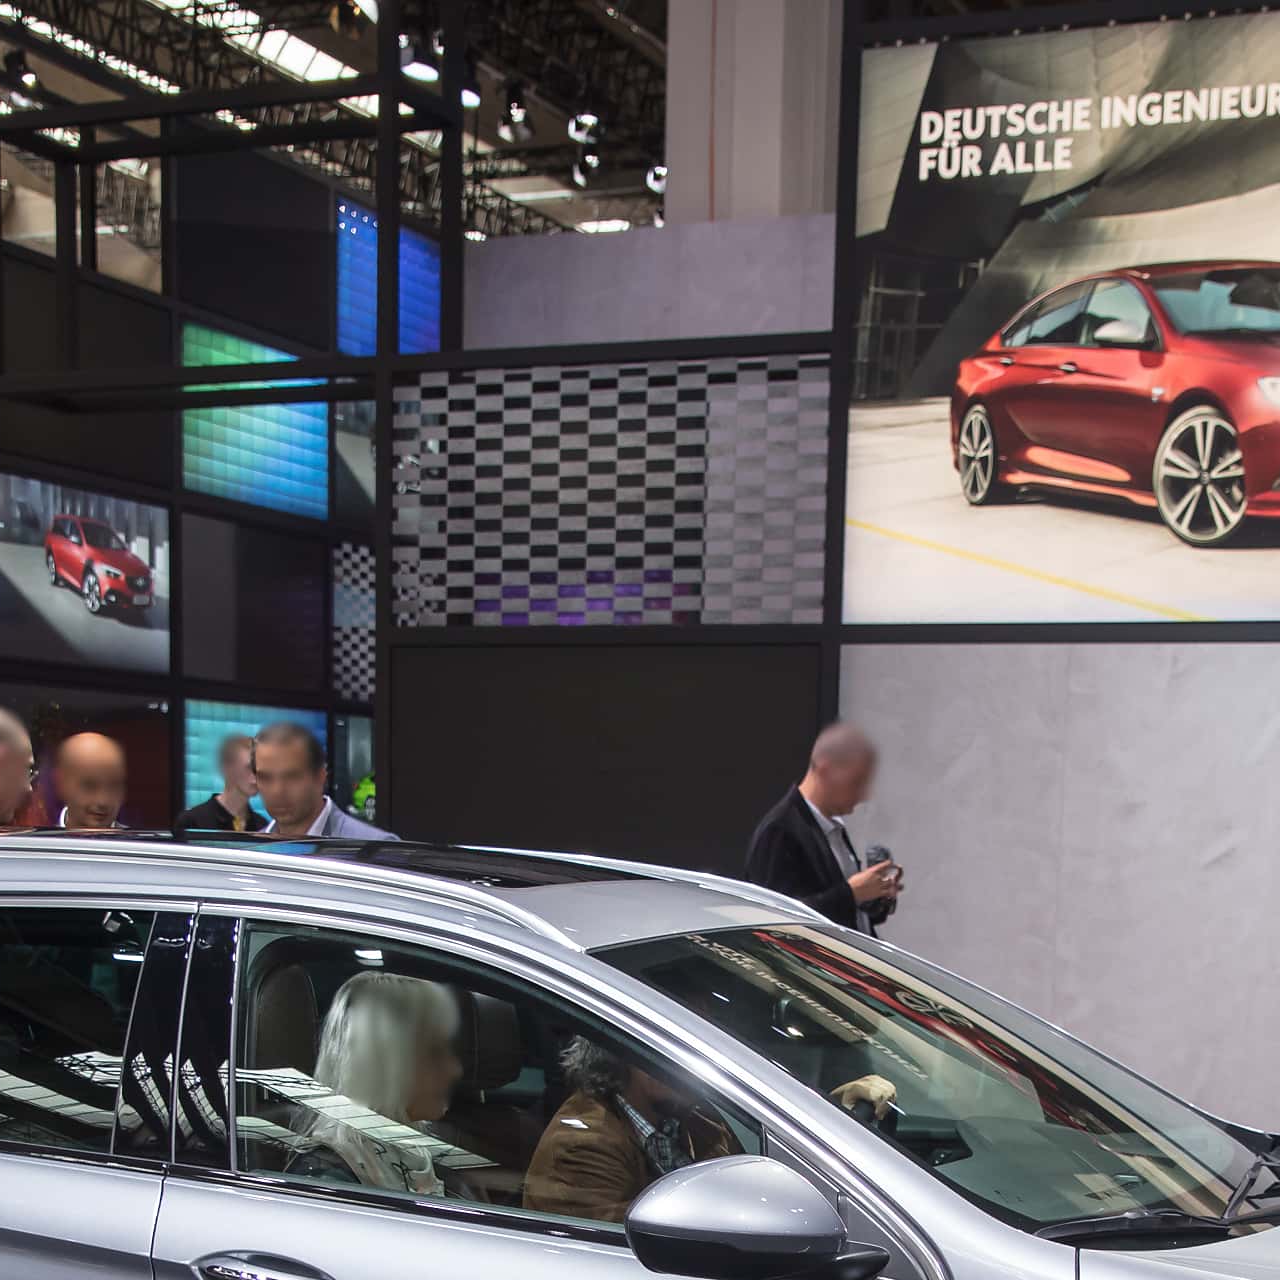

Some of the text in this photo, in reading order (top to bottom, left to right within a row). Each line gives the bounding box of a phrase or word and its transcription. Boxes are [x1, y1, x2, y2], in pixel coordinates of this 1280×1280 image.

[920, 98, 1092, 145] DEUTSCHE
[918, 138, 1074, 181] FÜR ALLE
